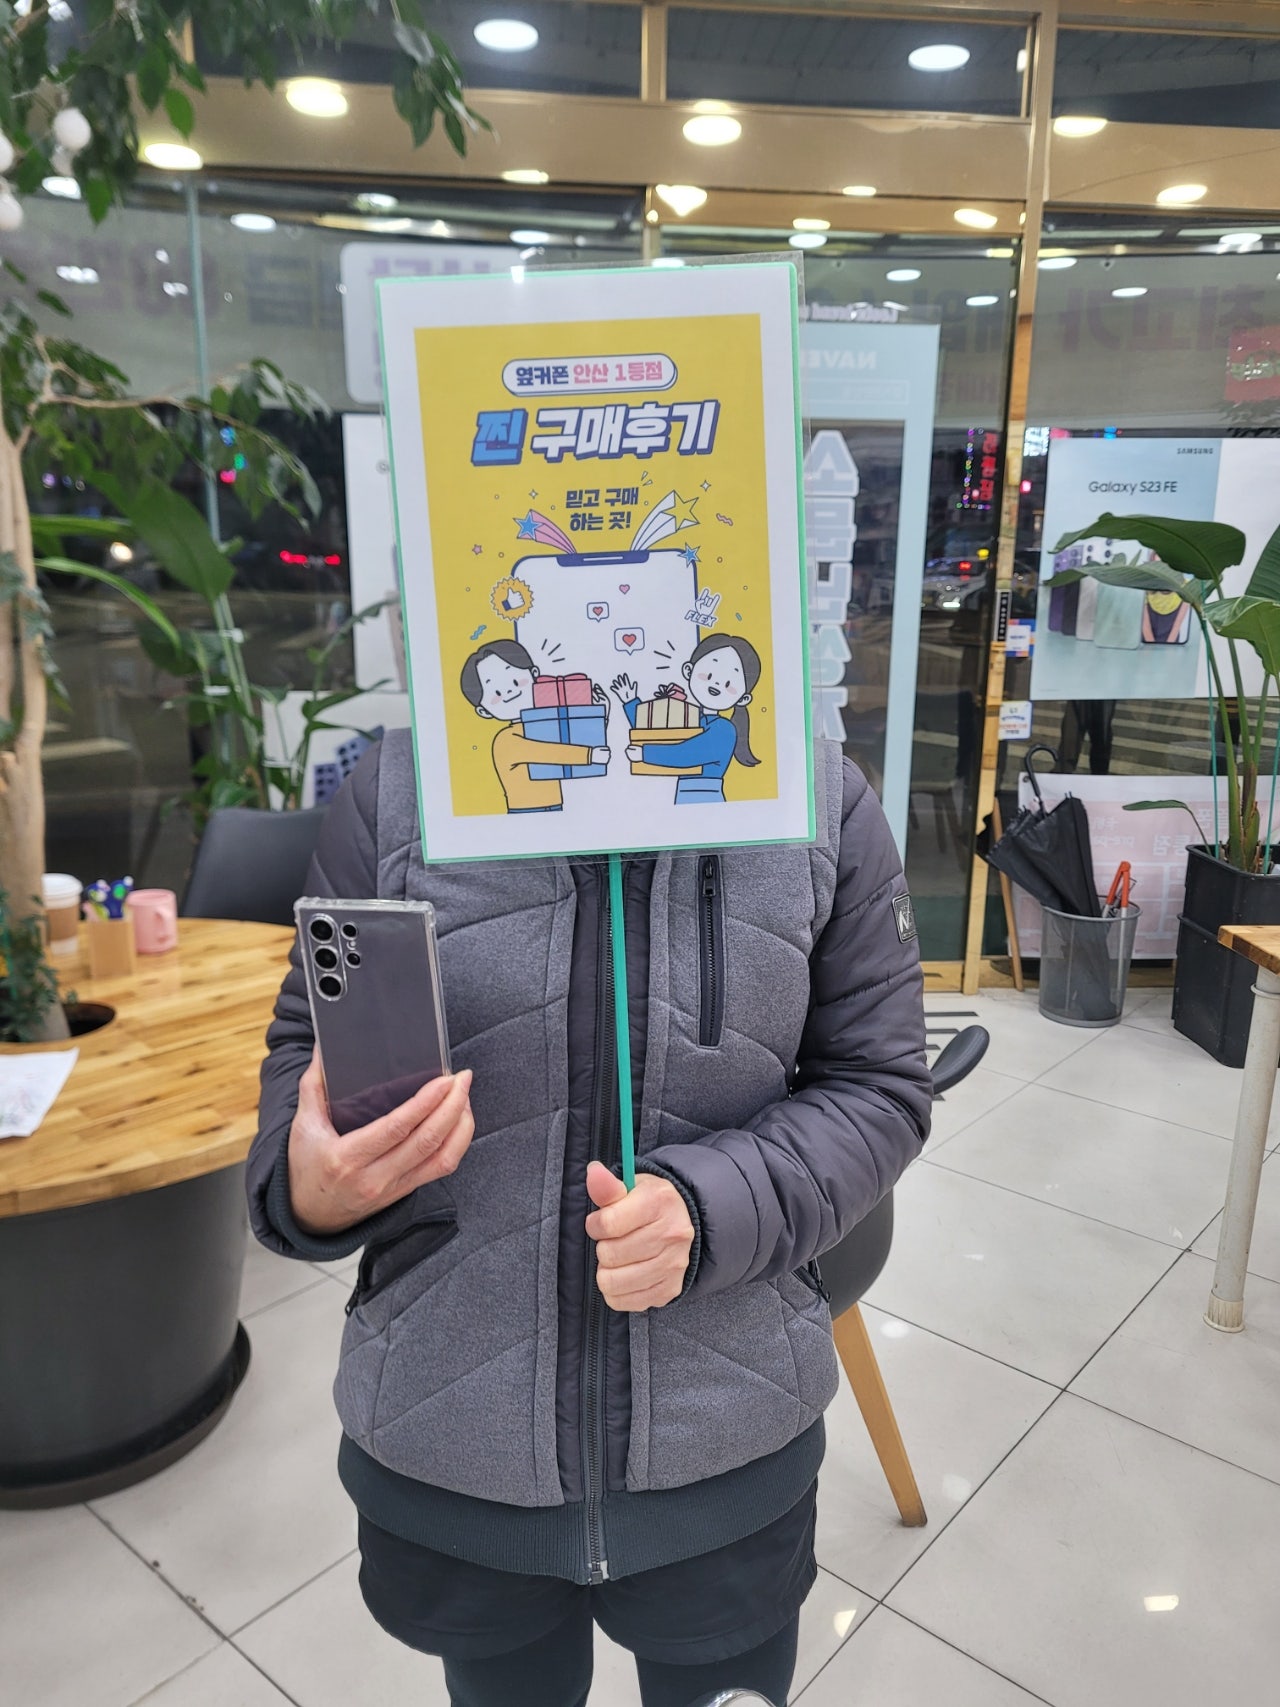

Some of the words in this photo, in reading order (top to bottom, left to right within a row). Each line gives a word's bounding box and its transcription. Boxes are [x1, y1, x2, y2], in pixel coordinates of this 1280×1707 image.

[516, 365, 569, 386] 옆커폰
[573, 363, 608, 384] 안산
[615, 361, 662, 382] 1등점
[471, 408, 528, 466] 찐
[530, 400, 721, 463] 구매후기
[1176, 447, 1214, 455] SAMSUNG
[566, 489, 600, 508] 믿고
[604, 487, 639, 506] 구매
[1088, 481, 1138, 495] Galaxy
[1139, 481, 1161, 493] S23
[1164, 481, 1178, 493] FE
[570, 513, 604, 531] 하는
[608, 511, 631, 530] 곳!
[684, 610, 717, 627] FLEX
